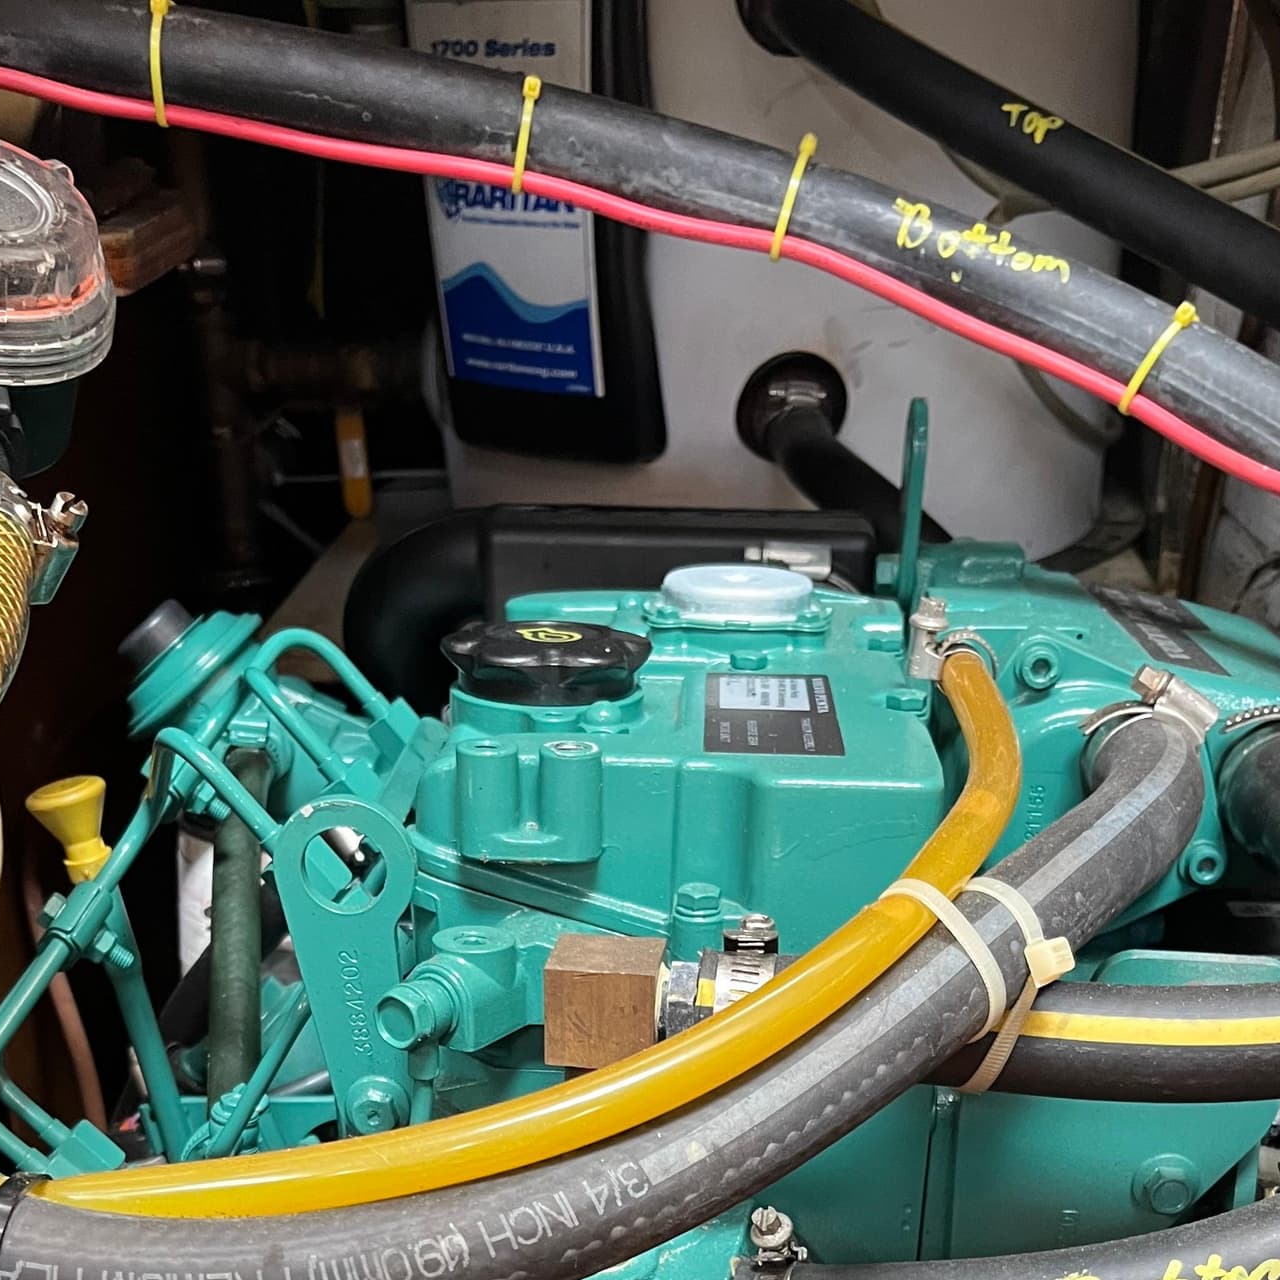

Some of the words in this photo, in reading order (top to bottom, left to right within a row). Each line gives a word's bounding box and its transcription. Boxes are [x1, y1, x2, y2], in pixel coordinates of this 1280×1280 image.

[432, 39, 479, 57] 1700
[484, 38, 556, 57] Series
[893, 197, 1070, 283] Bottom
[337, 949, 373, 1056] 3884202
[583, 1161, 649, 1216] 3/4
[477, 1190, 580, 1259] INCH
